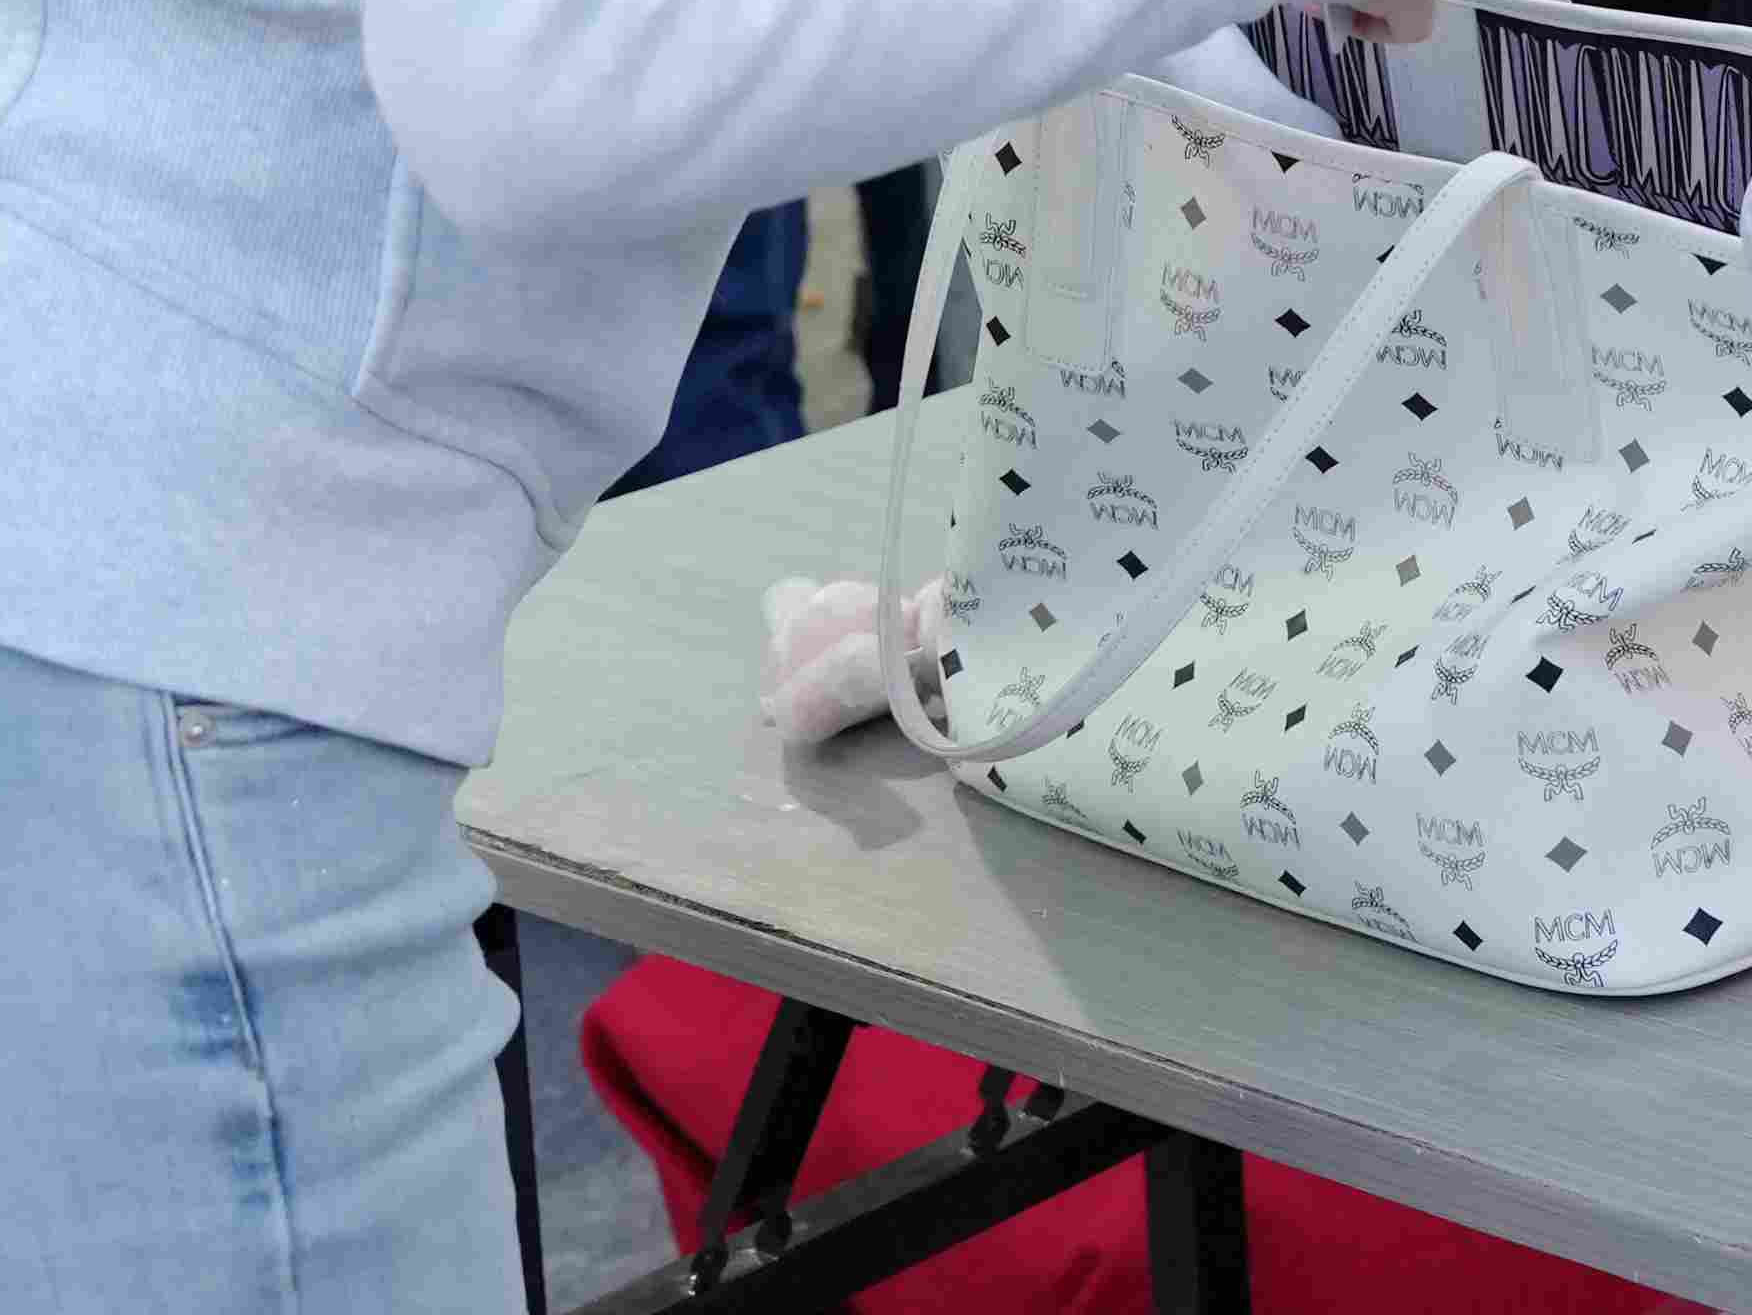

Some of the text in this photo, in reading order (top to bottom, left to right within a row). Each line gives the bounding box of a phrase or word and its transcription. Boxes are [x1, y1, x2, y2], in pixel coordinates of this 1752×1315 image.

[1251, 207, 1319, 244] MCM
[1161, 263, 1219, 303] MCM
[1592, 345, 1664, 379] MCM
[1059, 369, 1127, 399] MCM
[981, 410, 1038, 449] MCM
[1175, 419, 1247, 445] MCM
[1089, 501, 1159, 529] MCM
[1295, 503, 1356, 541] MCM
[1394, 488, 1456, 528] MCM
[1001, 554, 1067, 579] MCM
[1115, 714, 1167, 752] MCM
[1517, 726, 1600, 755] MCM
[1323, 744, 1377, 785] MCM
[1242, 812, 1300, 850] MCM
[1415, 813, 1485, 848] MCM
[1651, 838, 1732, 880] MCM
[1534, 908, 1616, 943] MCM
